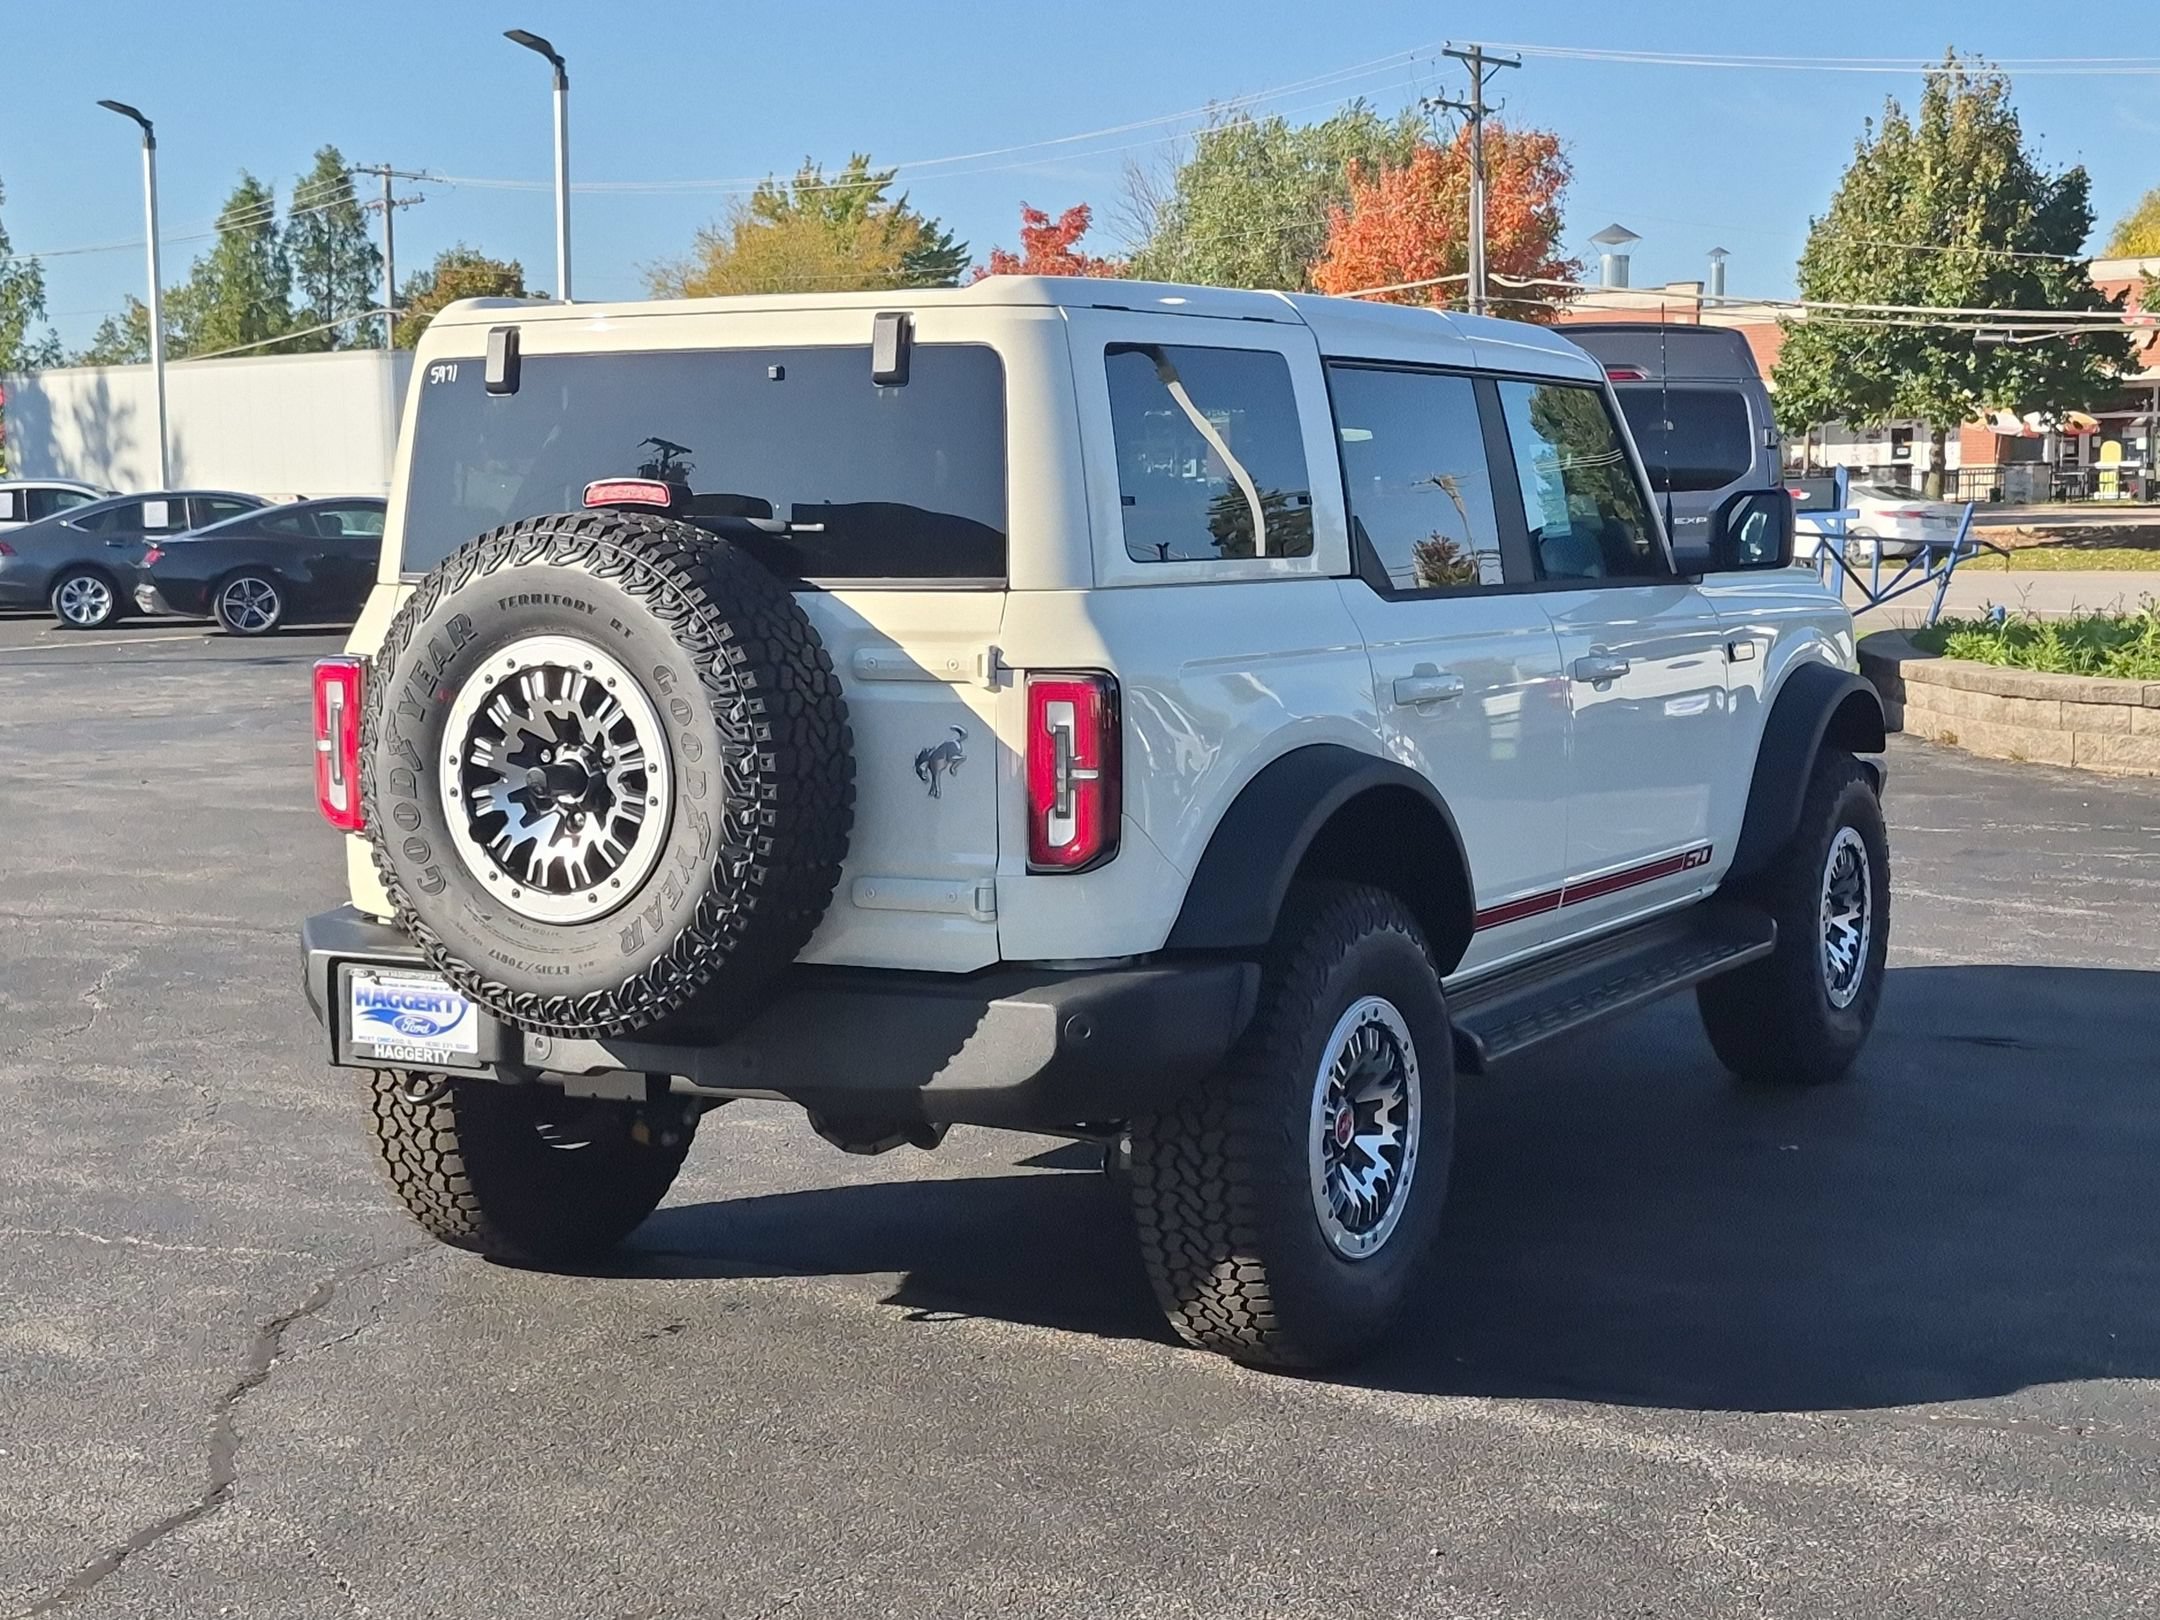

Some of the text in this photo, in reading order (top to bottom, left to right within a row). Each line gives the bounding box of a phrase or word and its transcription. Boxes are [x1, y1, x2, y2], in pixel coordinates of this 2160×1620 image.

[498, 593, 598, 616] TERRITORY
[385, 612, 479, 896] GOODYEAR
[617, 664, 712, 957] GOODYEAR
[401, 1017, 431, 1035] Ford
[374, 1044, 451, 1064] HAGGERTY
